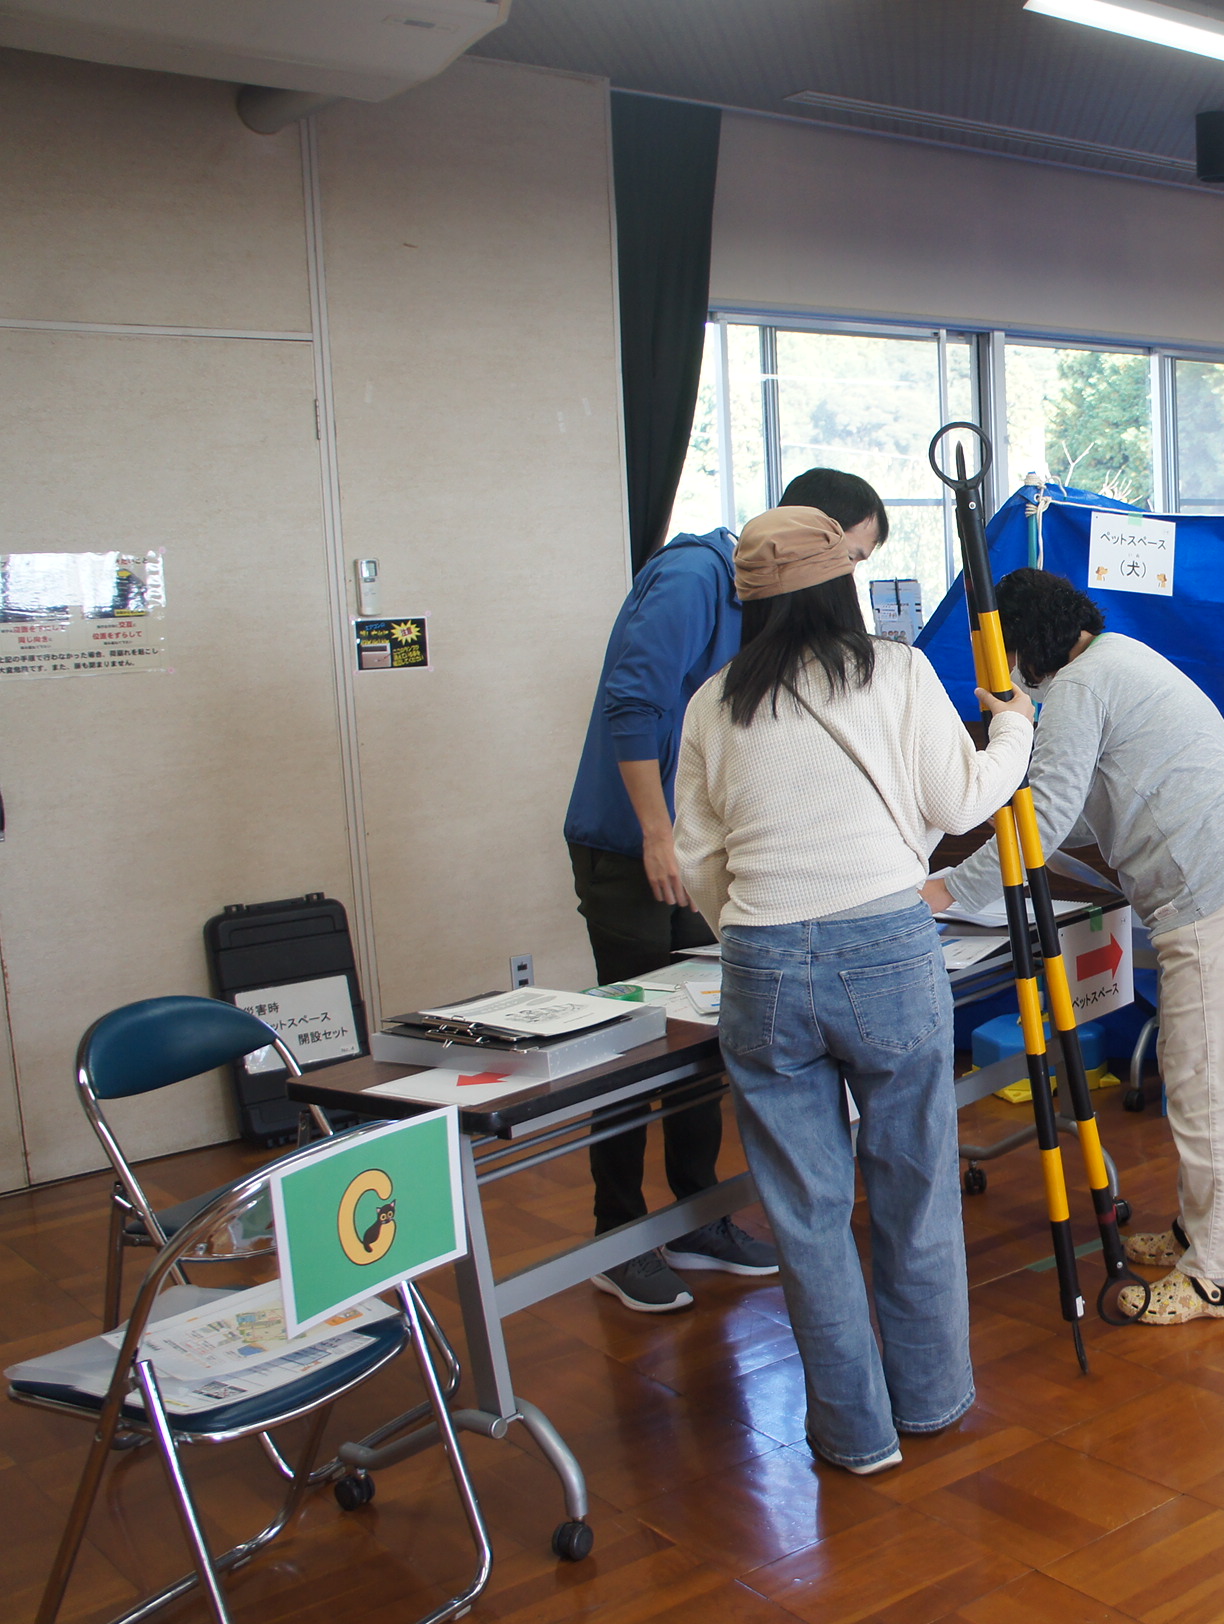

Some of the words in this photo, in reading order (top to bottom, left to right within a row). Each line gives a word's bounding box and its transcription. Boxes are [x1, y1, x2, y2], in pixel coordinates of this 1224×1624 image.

[1100, 531, 1166, 550] ペットスペース
[269, 1012, 331, 1031] ットスペース
[298, 1027, 348, 1045] 開設セット
